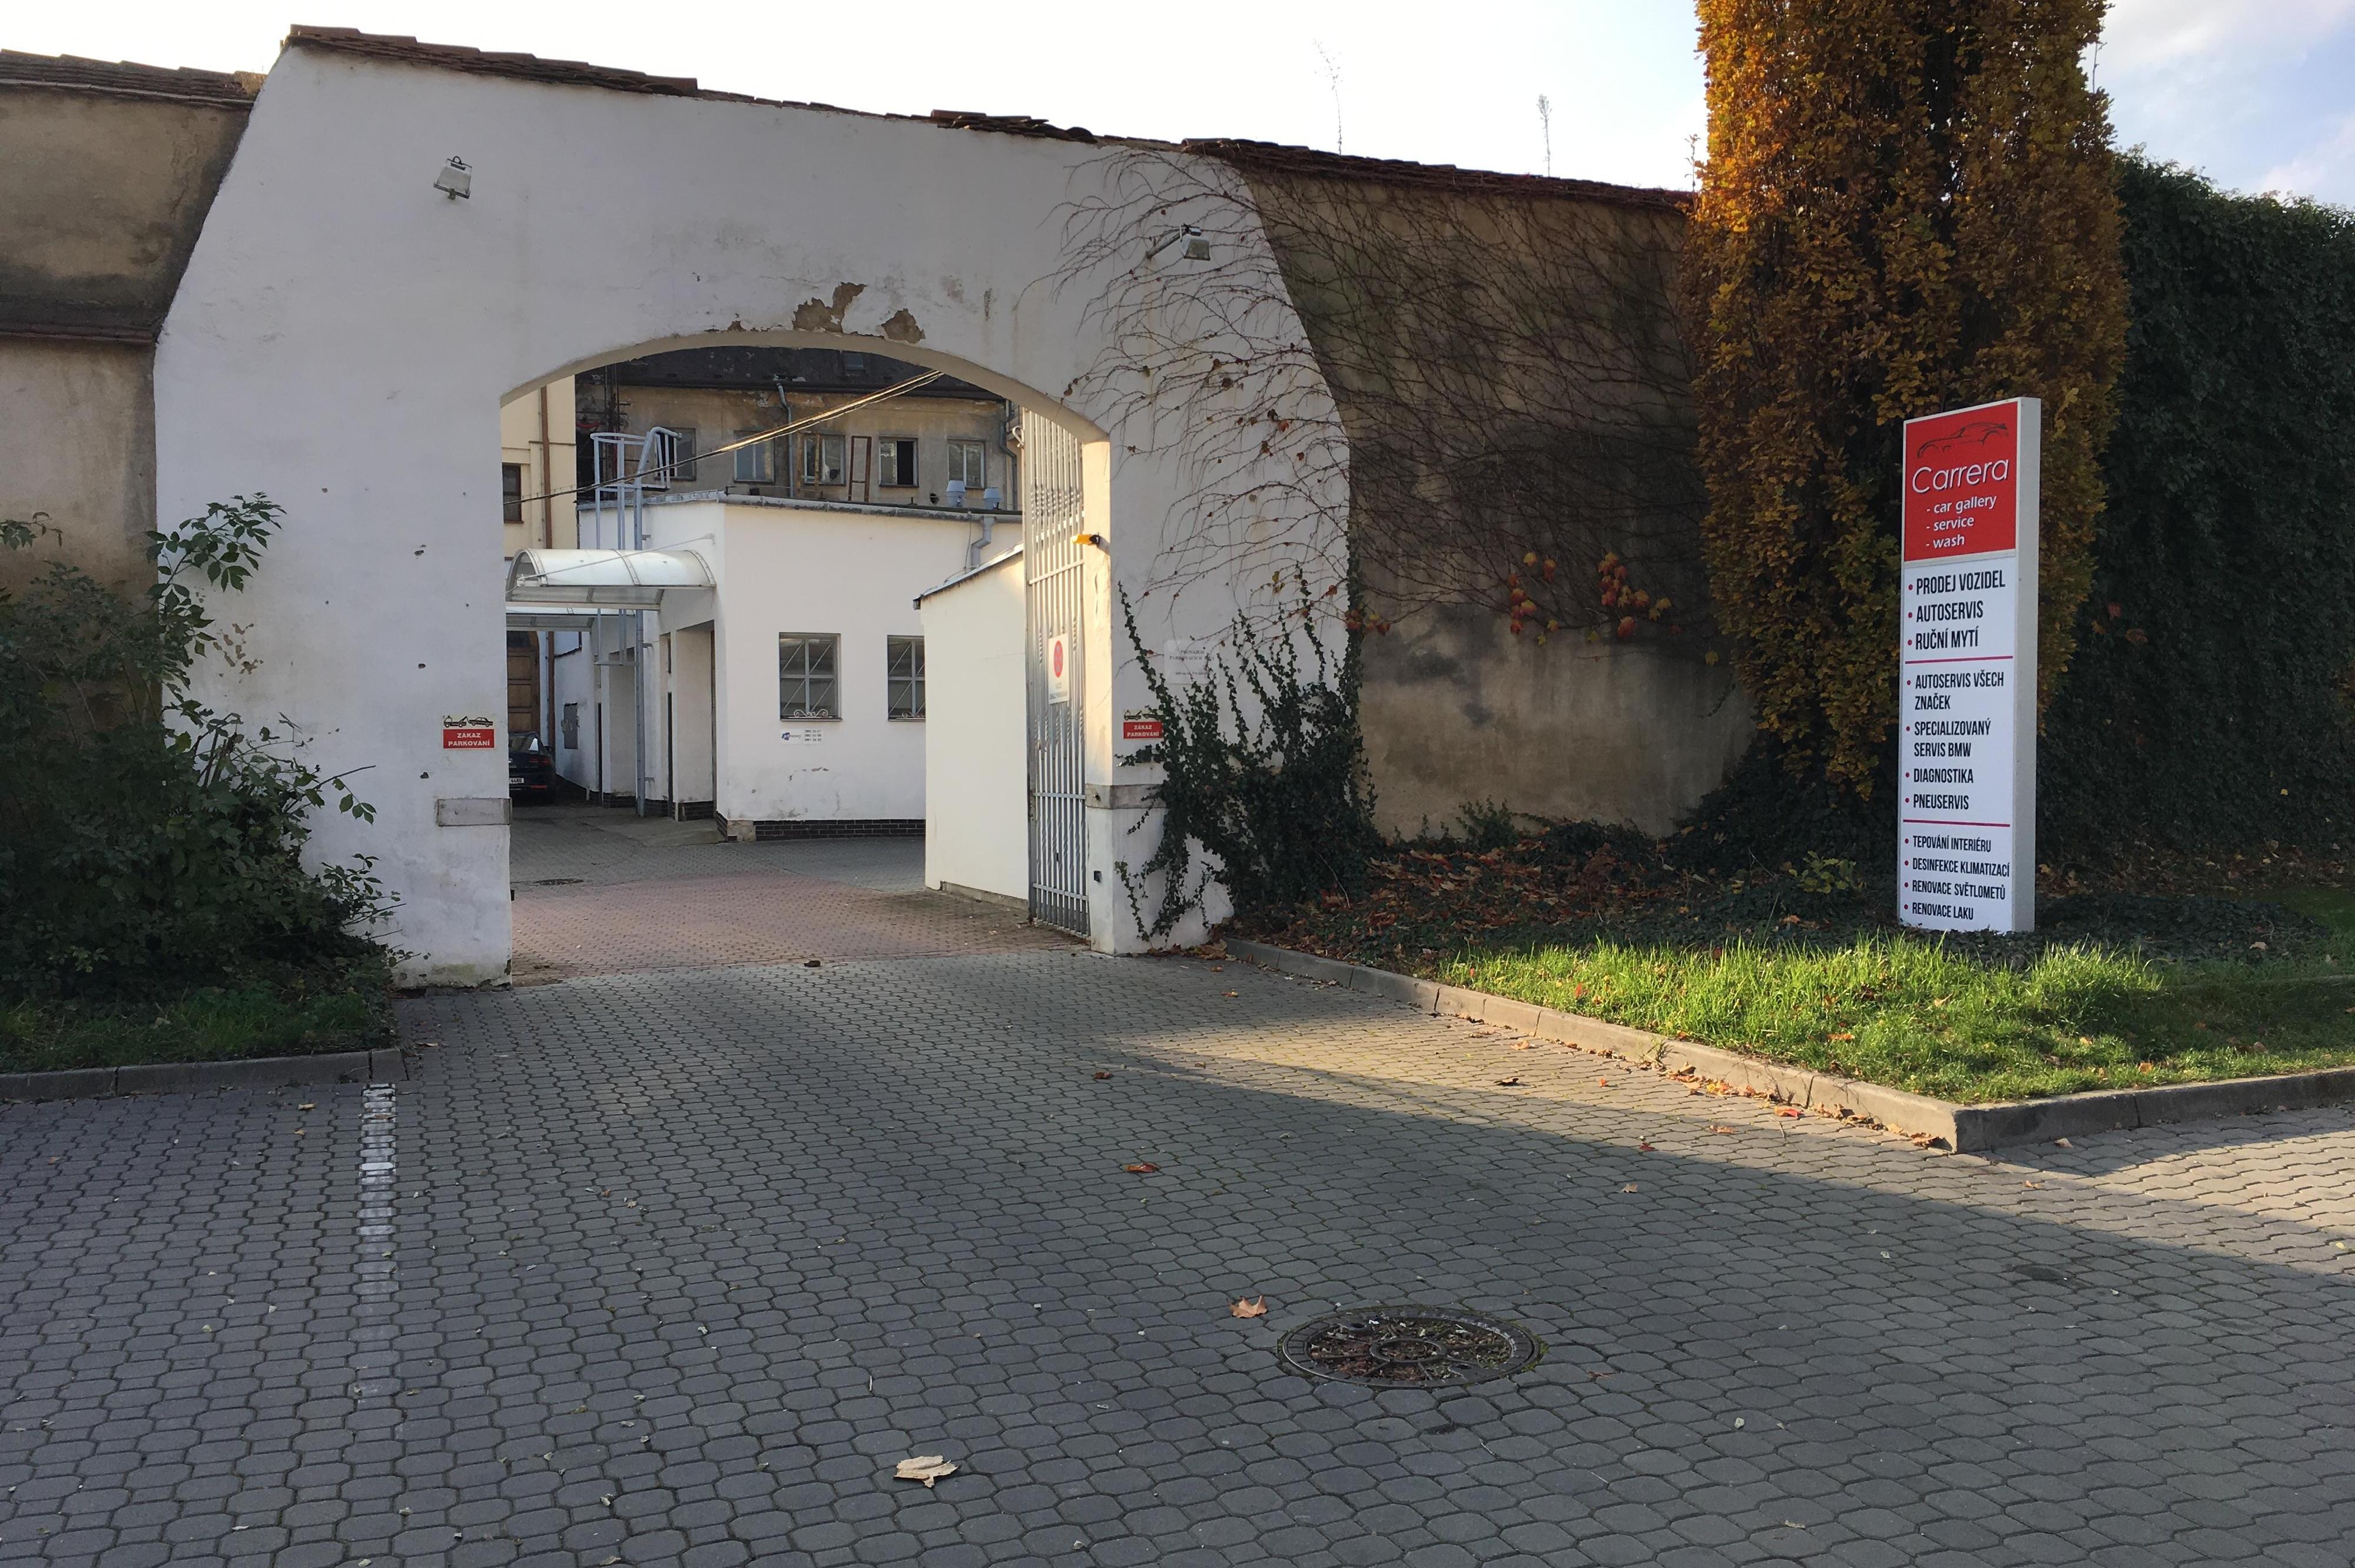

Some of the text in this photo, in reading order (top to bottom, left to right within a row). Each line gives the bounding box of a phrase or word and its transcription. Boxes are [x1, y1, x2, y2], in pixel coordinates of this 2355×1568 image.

[1912, 459, 2009, 493] Carrera
[1933, 495, 1997, 514] car gallery
[1933, 516, 1974, 531] service
[1933, 534, 1965, 549] wash
[1916, 569, 2006, 595] PRODEJ VOZIDEL
[1916, 600, 1983, 623] AUTOSERVIS
[1915, 625, 1979, 650] RUČNÍ MYTÍ
[1915, 669, 2005, 689] AUTOSERVIS VŠECH
[1914, 692, 1951, 710] ZNAČEK
[1913, 717, 1992, 736] SPECIALIZOVANÝ
[1913, 742, 1972, 758] SERVIS BMW
[1913, 768, 1974, 784] DIAGNOSTIKA
[1913, 793, 1969, 810] PNEUSERVIS
[1912, 834, 1992, 853] TEPOVÁNÍ INTERIÉRU
[1912, 857, 2011, 878] DESINFEKCE KLIMATIZACÍ
[1912, 879, 2006, 901] RENOVACE SVĚTLOMETŮ
[1912, 901, 1973, 921] RENOVACE LAKU
